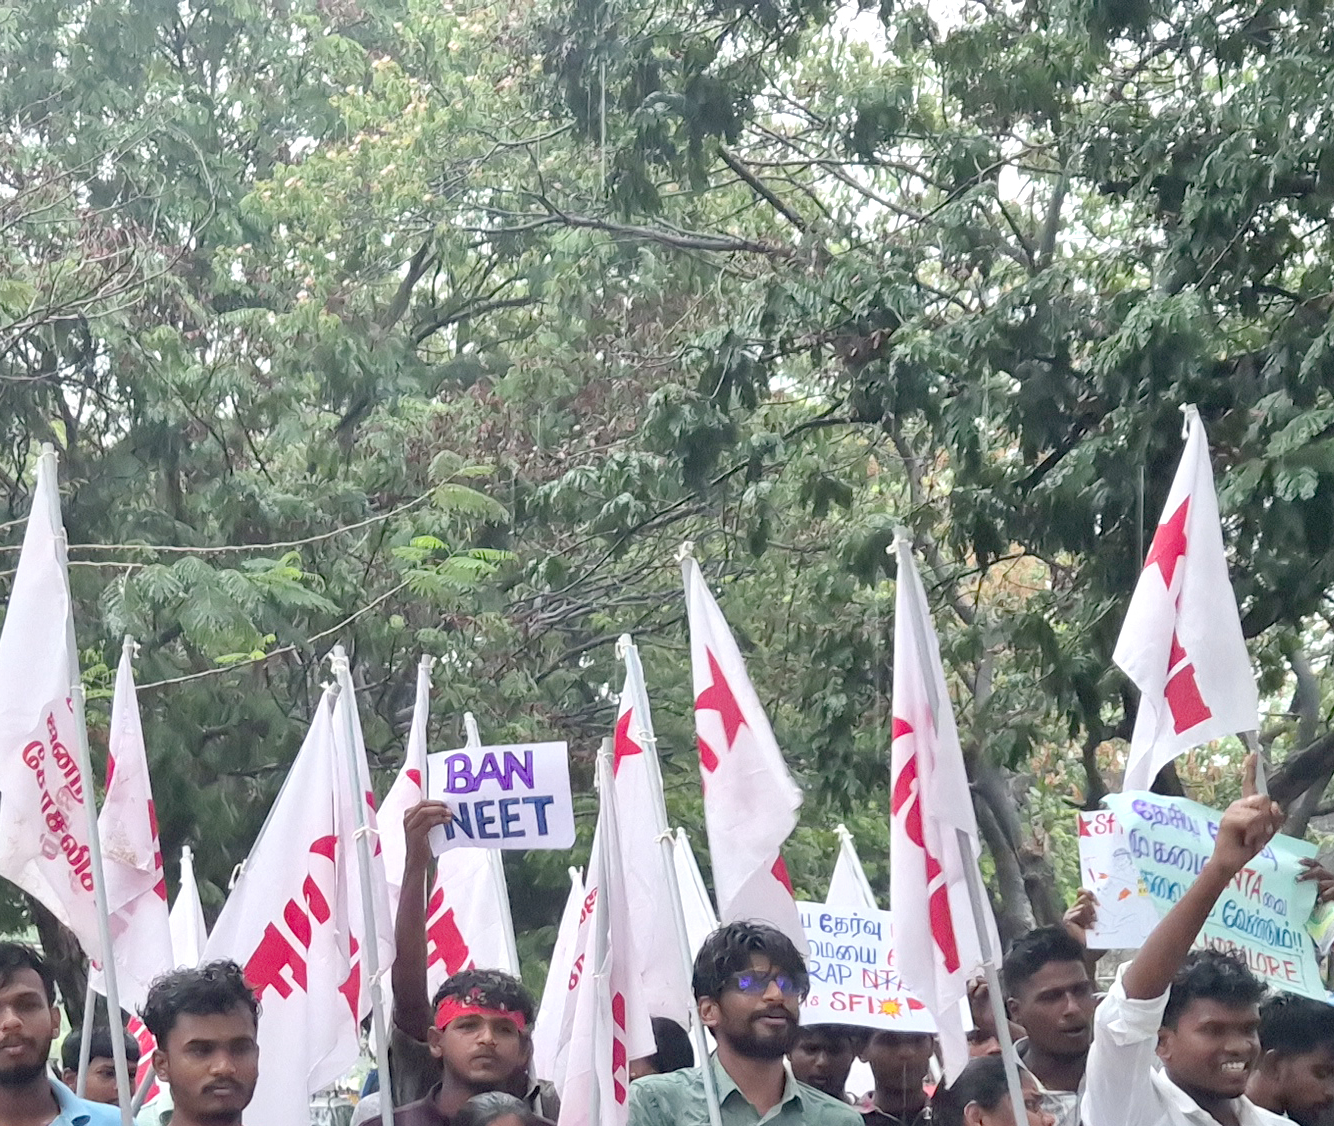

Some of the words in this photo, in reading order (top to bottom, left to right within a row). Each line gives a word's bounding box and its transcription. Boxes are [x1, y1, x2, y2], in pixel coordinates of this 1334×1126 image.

[443, 750, 535, 794] BAN
[443, 795, 554, 841] NEET
[830, 991, 875, 1014] SFI
